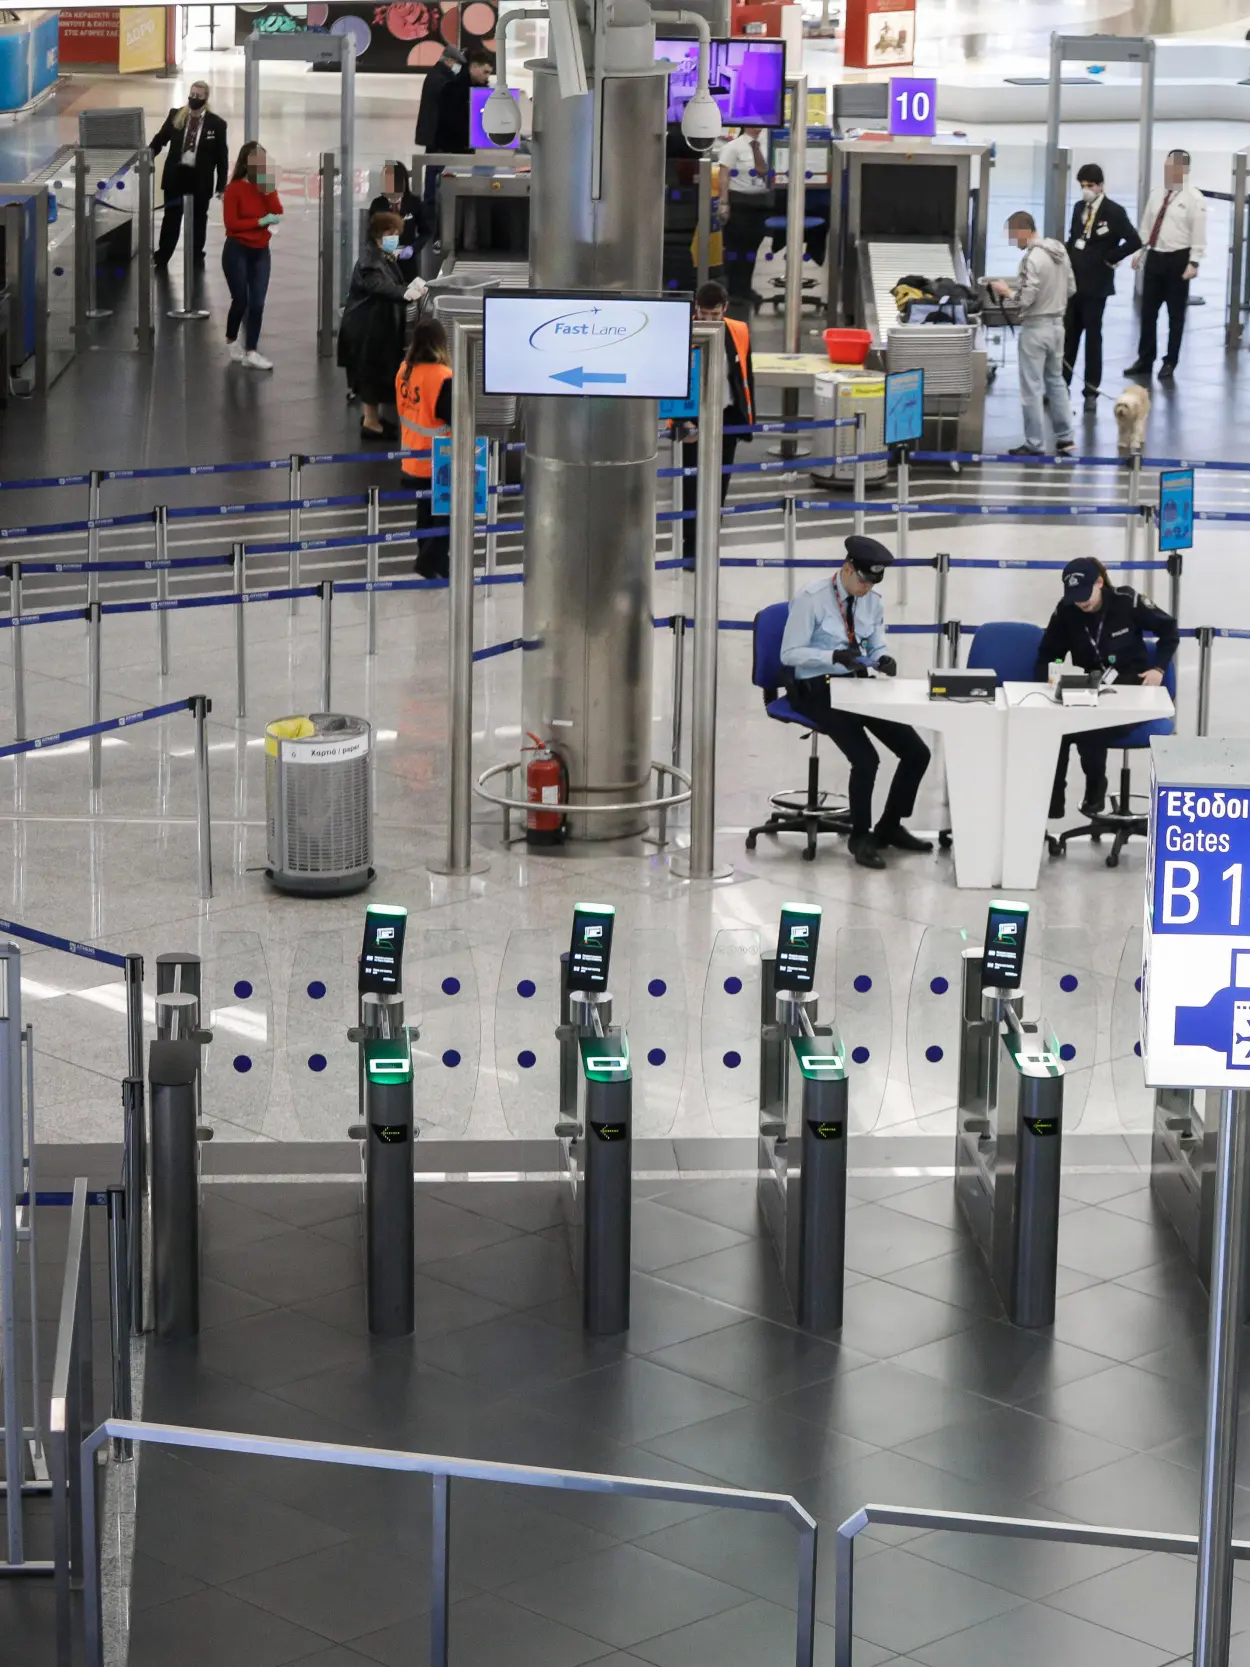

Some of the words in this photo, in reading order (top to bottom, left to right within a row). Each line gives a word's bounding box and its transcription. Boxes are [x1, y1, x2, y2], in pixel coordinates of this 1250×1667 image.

[896, 91, 930, 121] 10
[554, 322, 589, 335] Fast
[591, 325, 627, 336] Lane
[1159, 790, 1249, 823] Έξοδοι
[1165, 825, 1231, 853] Gates
[1162, 860, 1201, 925] B
[76, 943, 96, 955] ATHENS
